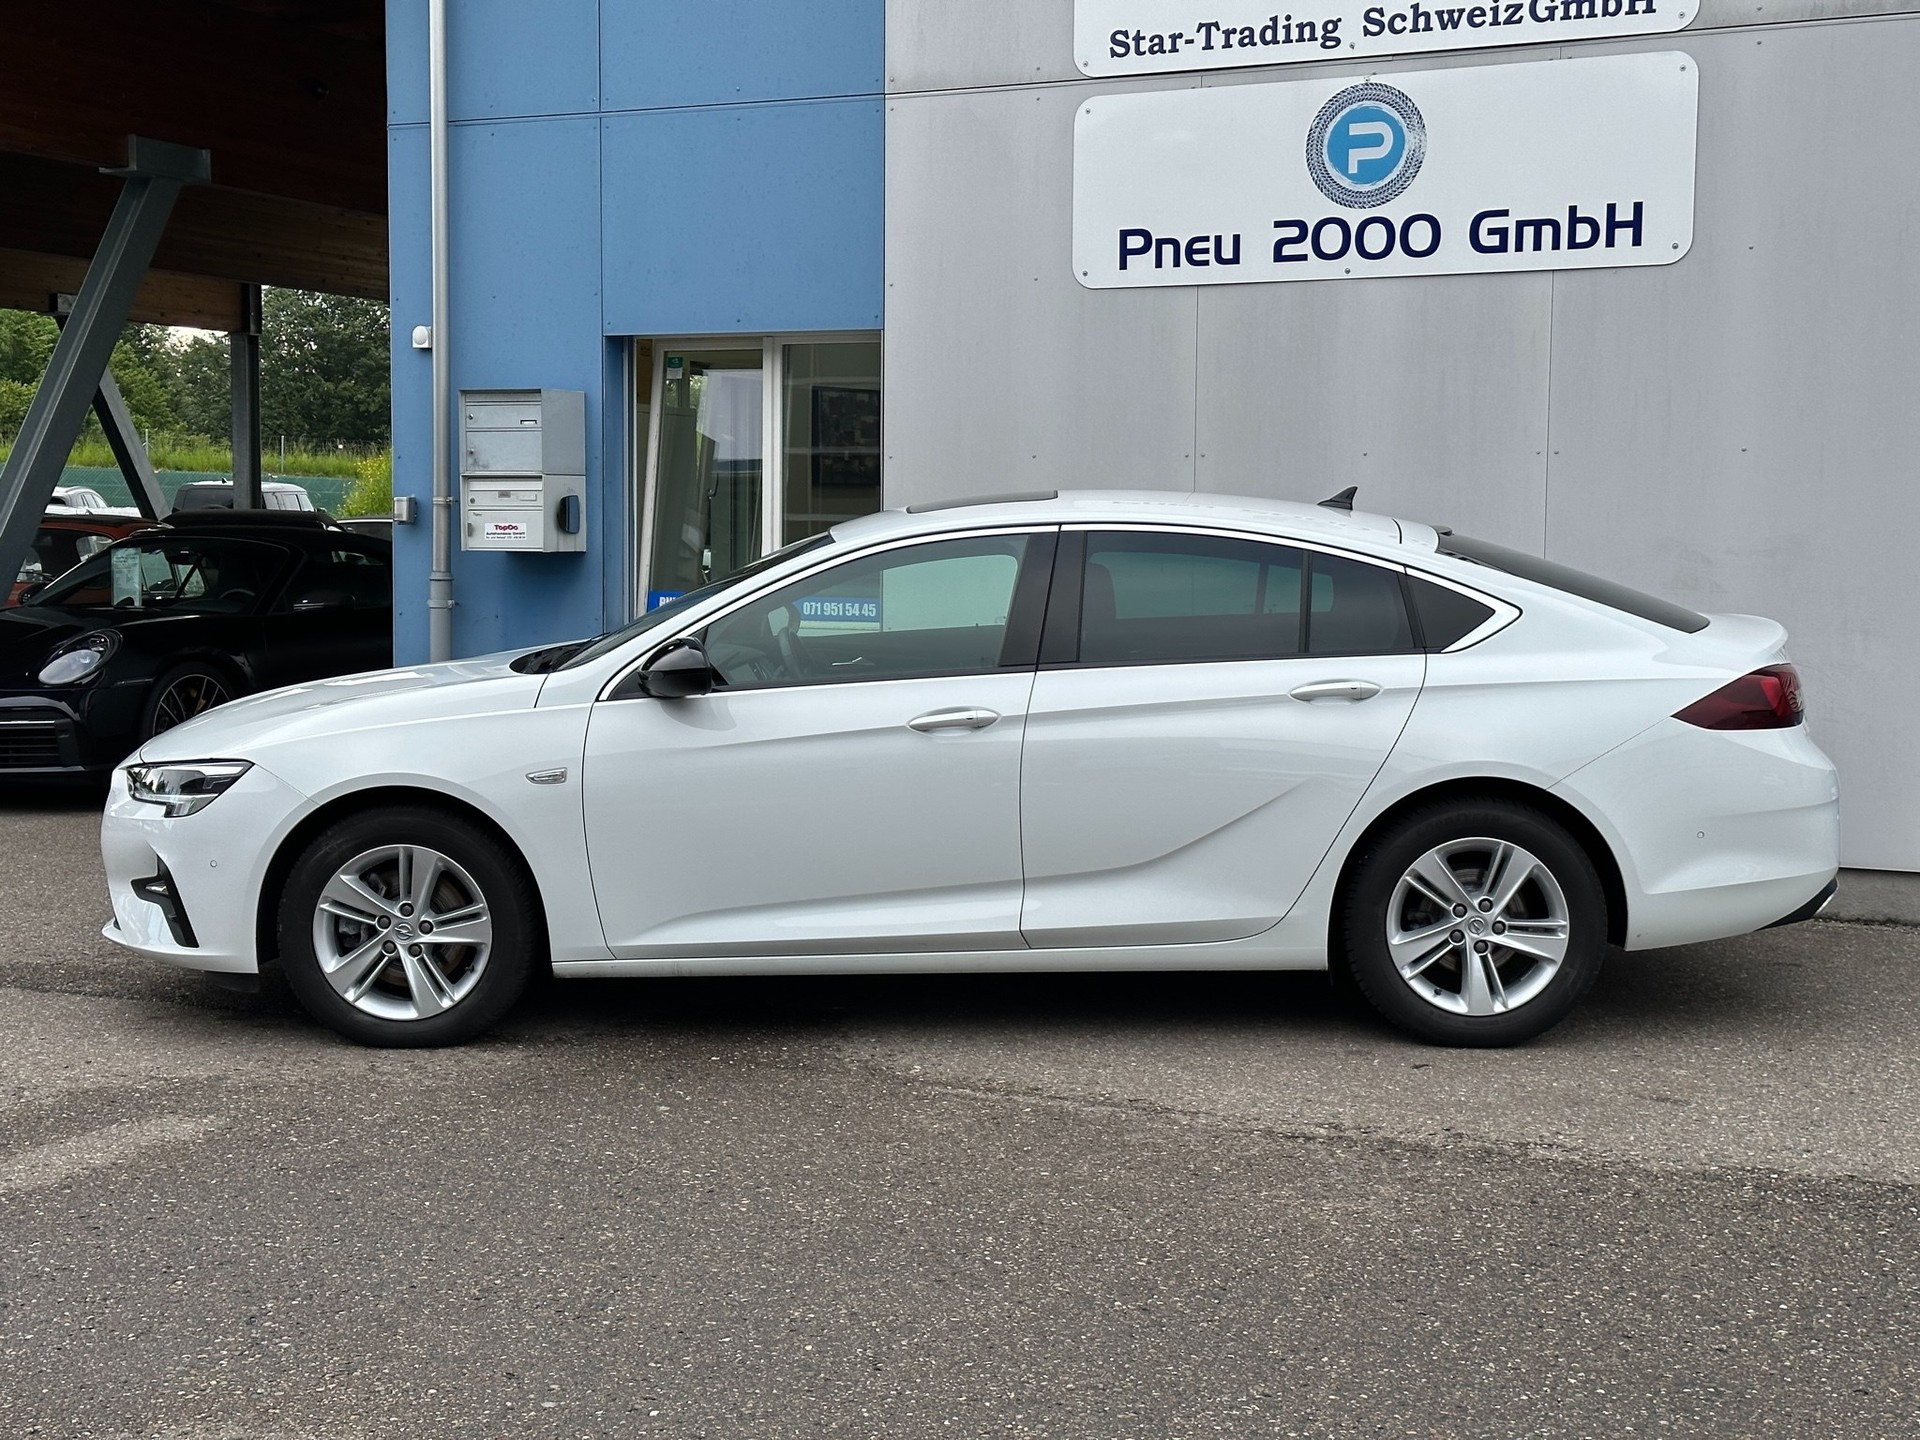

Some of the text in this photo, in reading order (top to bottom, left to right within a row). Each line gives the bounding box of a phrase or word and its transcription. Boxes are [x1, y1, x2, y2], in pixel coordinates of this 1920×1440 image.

[1109, 14, 1342, 58] Star-Trading
[1348, 121, 1394, 174] P
[1119, 201, 1644, 271] Pneu 2000 GmbH
[803, 601, 877, 617] 071 951 54 45
